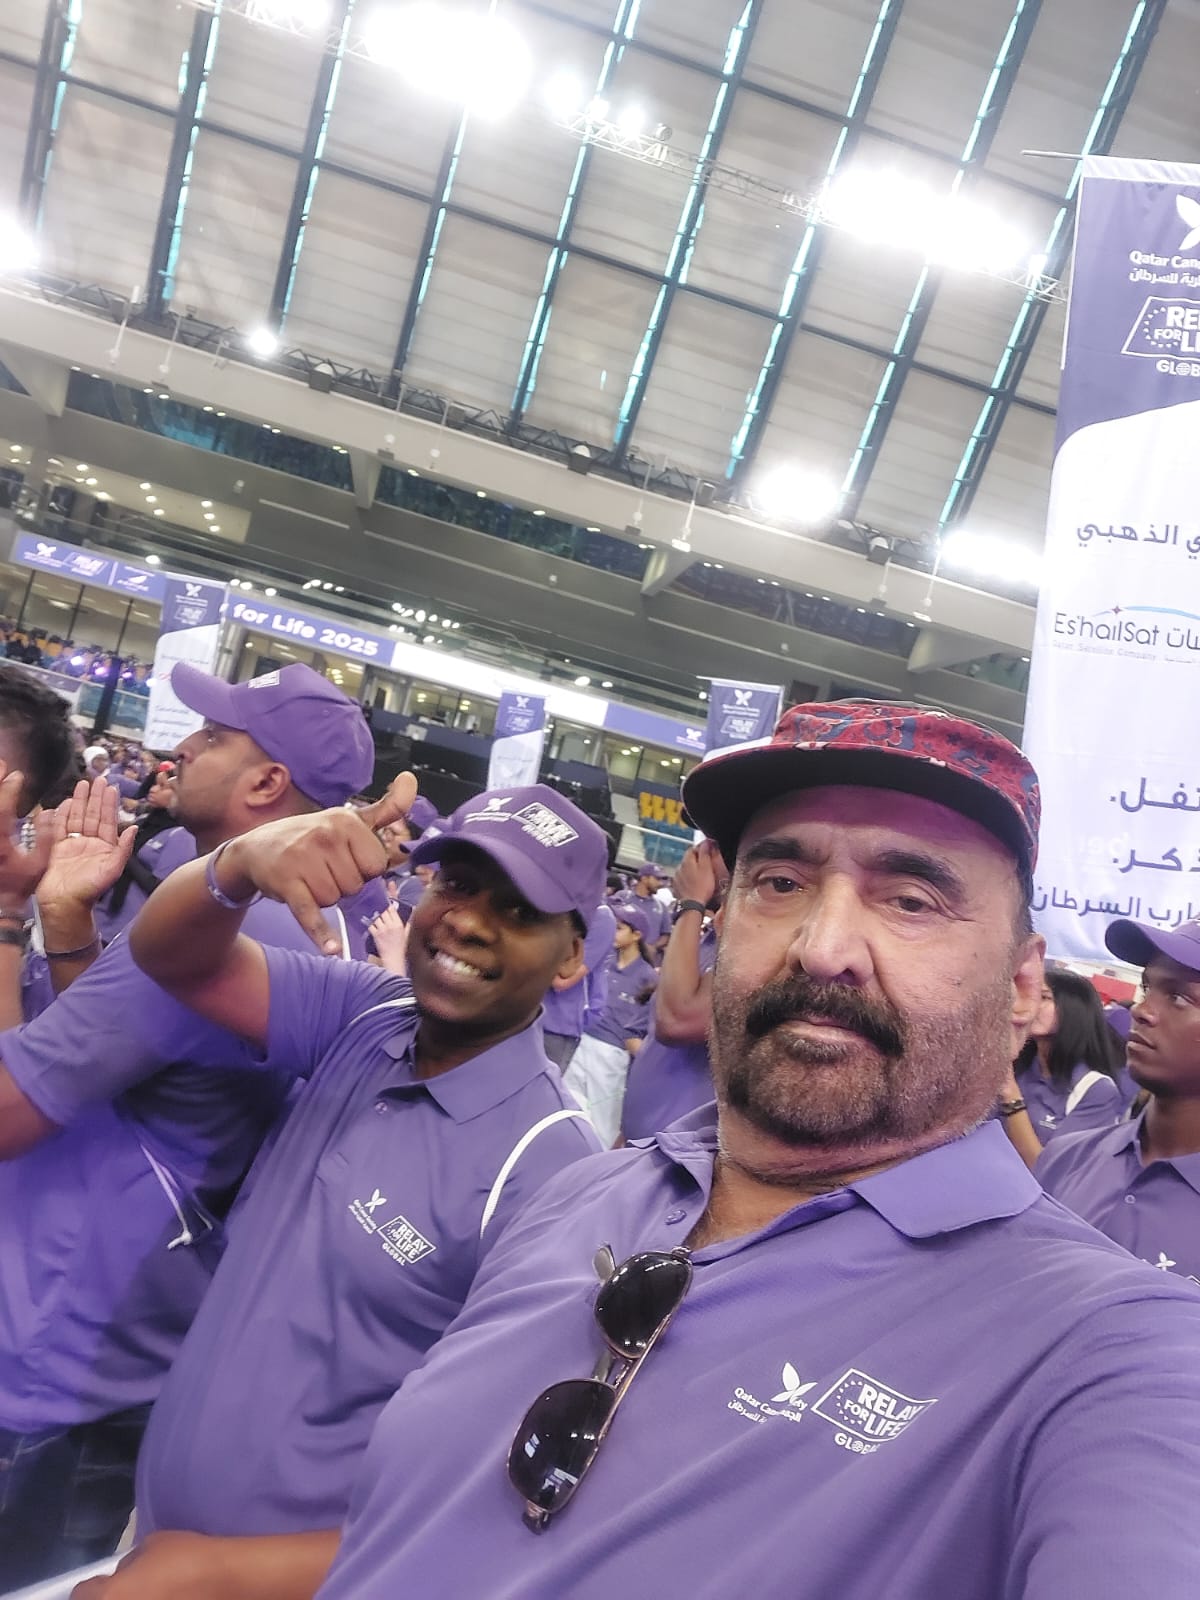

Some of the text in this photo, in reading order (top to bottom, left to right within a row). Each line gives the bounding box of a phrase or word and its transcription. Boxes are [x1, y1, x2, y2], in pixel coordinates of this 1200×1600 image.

[1130, 250, 1170, 266] Qatar
[1166, 306, 1200, 330] RE
[1153, 328, 1182, 341] FOR
[1077, 523, 1178, 548] الذهبي
[233, 603, 268, 624] for
[272, 614, 317, 639] Life
[319, 628, 379, 656] 2025
[1030, 886, 1141, 919] السرطان
[397, 1223, 428, 1252] RELAY
[734, 1387, 761, 1408] Qatar
[857, 1383, 926, 1422] RELAY
[844, 1399, 909, 1437] FOR LIFE
